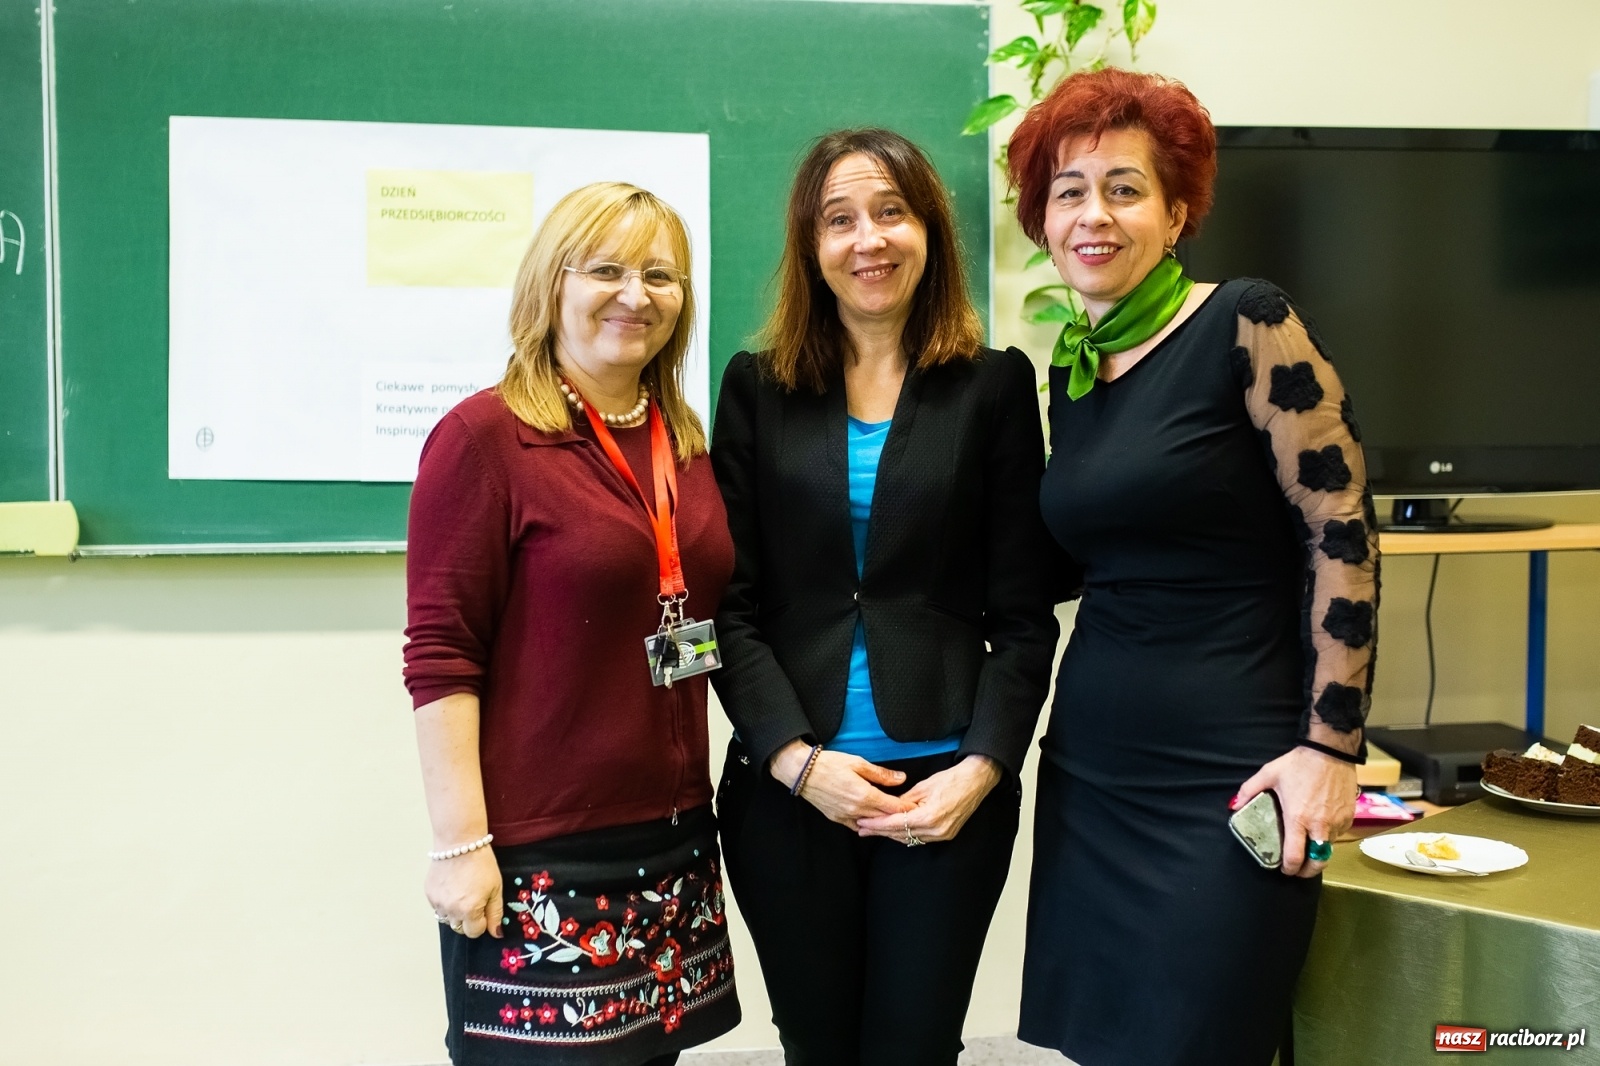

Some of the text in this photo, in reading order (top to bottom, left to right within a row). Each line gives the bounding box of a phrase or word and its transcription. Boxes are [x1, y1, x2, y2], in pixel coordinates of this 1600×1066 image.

[380, 185, 416, 198] DZIEŃ
[380, 208, 506, 223] PRZEDSIĘBIORCZOŚCI
[375, 381, 424, 392] Ciekawe
[376, 403, 438, 415] Kreatywne
